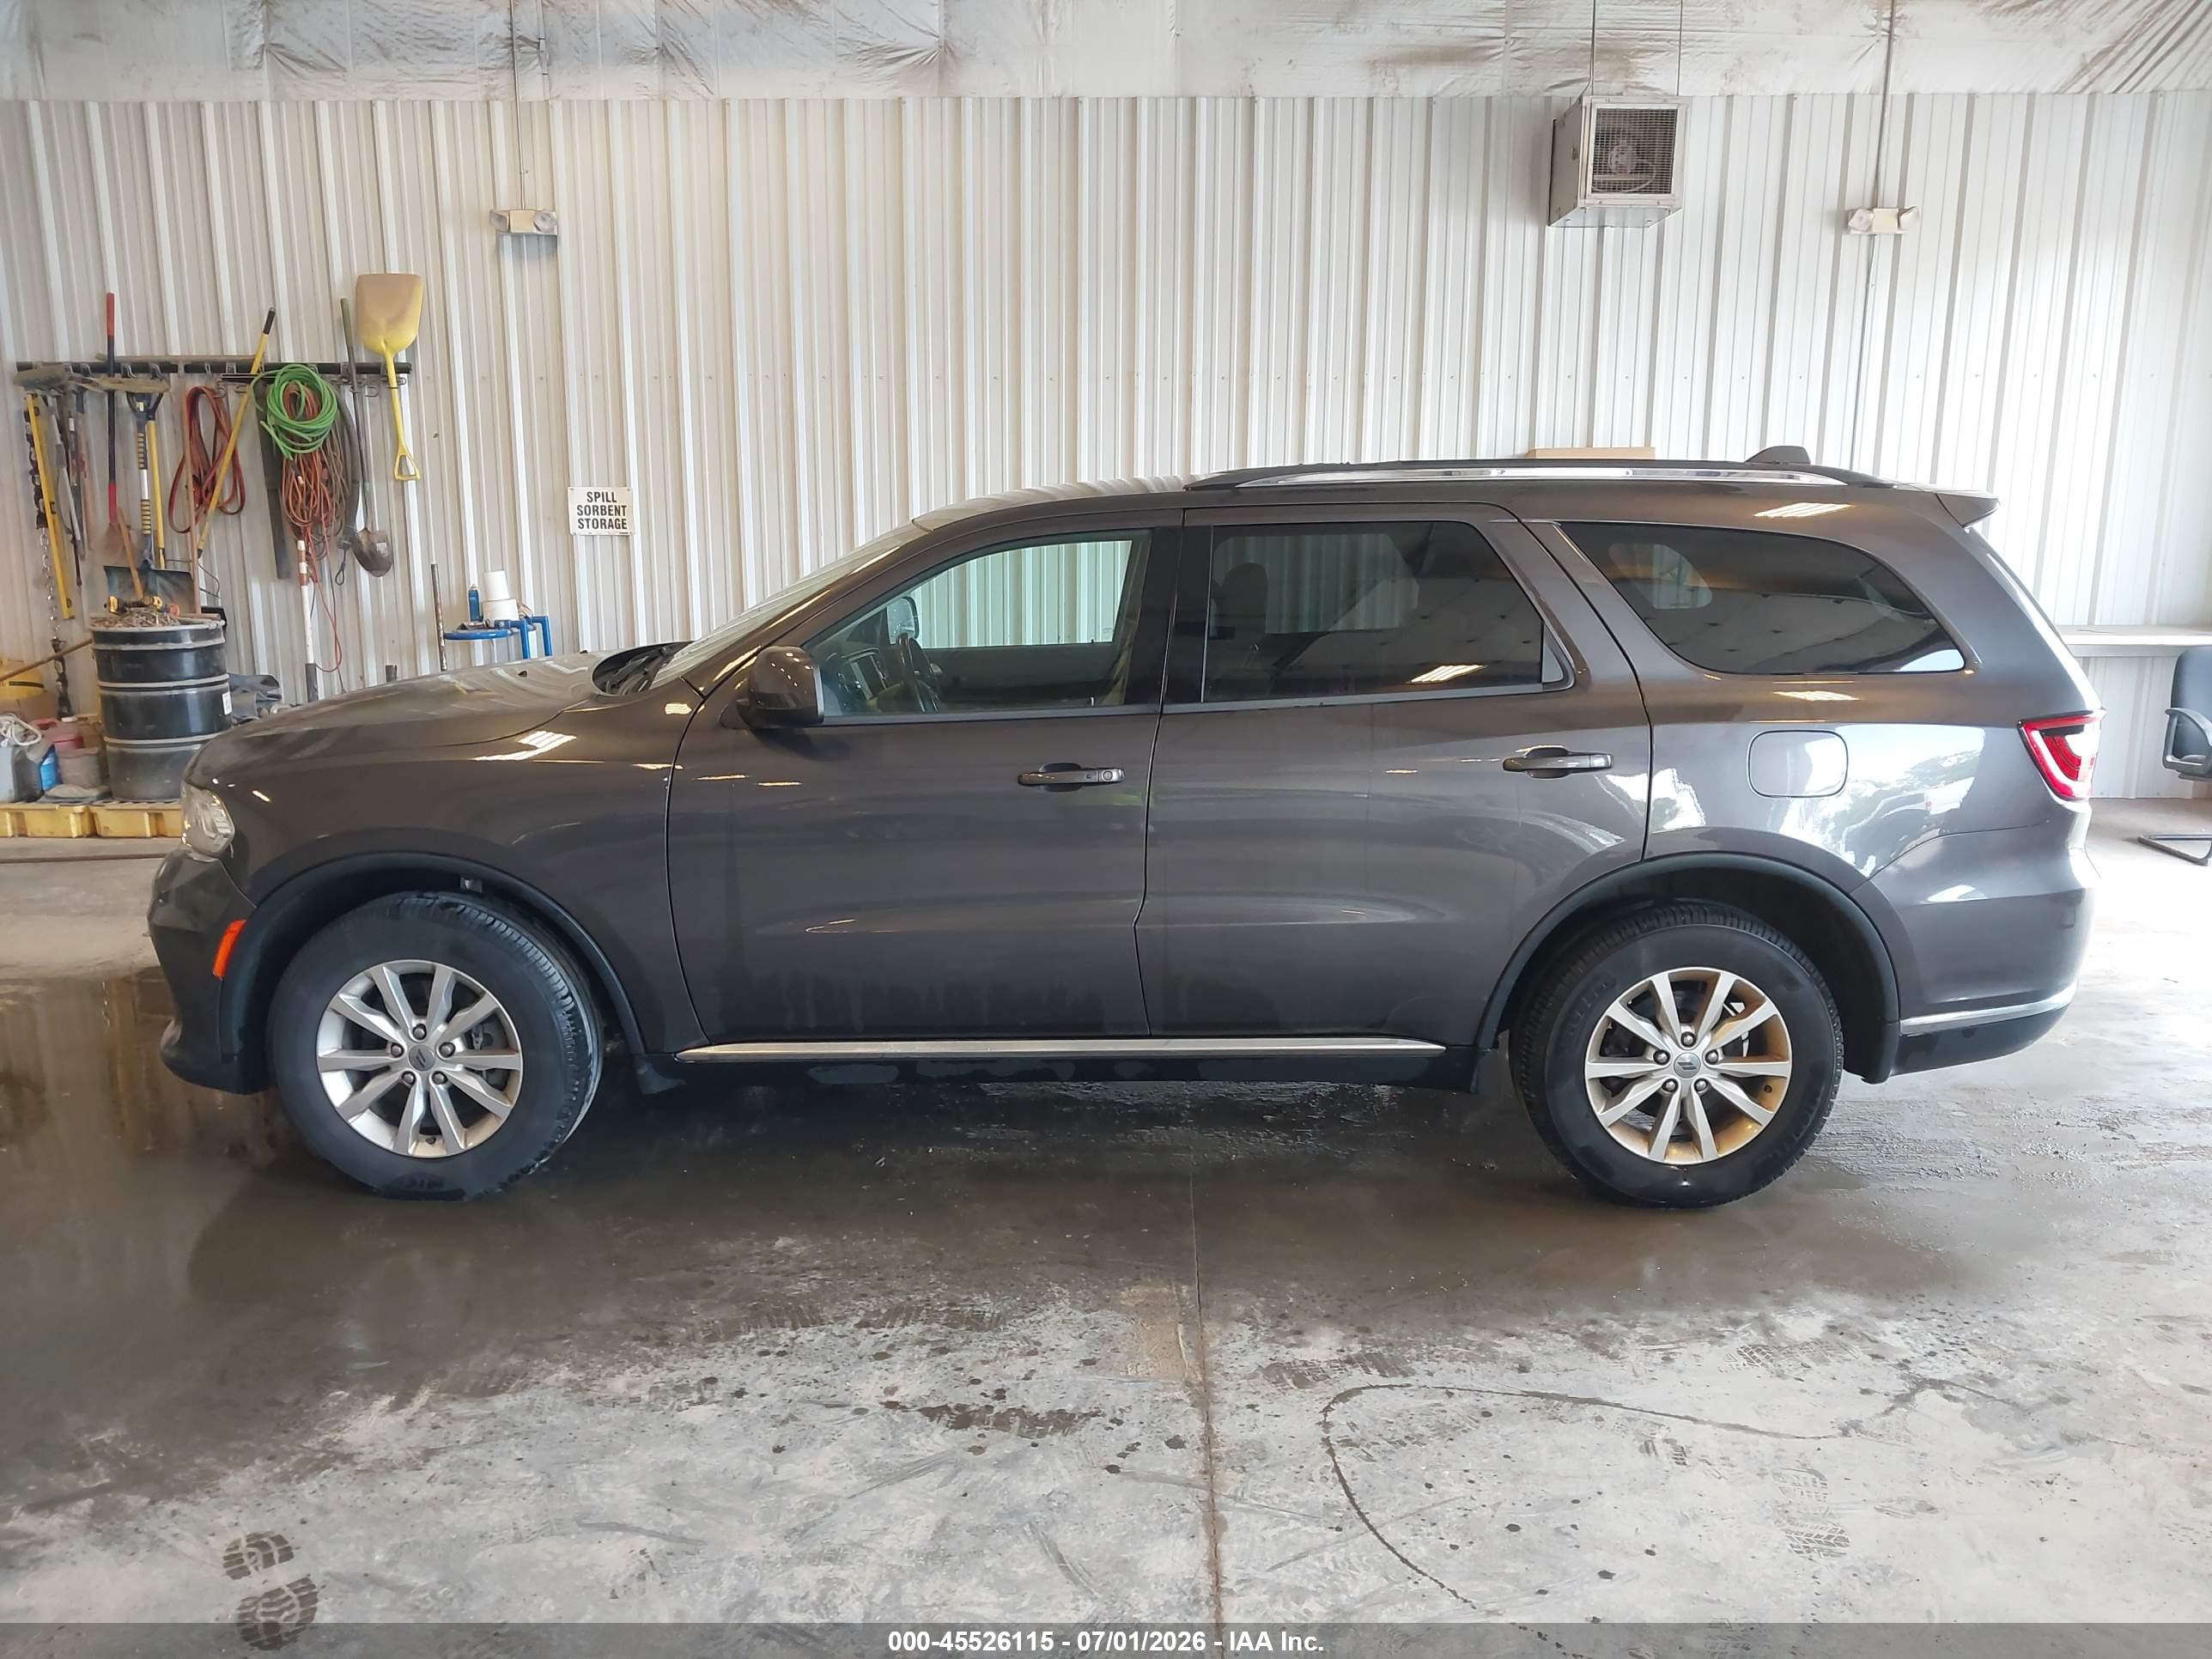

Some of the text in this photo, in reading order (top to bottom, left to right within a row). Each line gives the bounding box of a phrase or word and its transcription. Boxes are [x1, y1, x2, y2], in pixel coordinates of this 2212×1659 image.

[586, 491, 617, 502] SPILL
[576, 505, 627, 516] SORBENT
[577, 518, 628, 529] STORAGE
